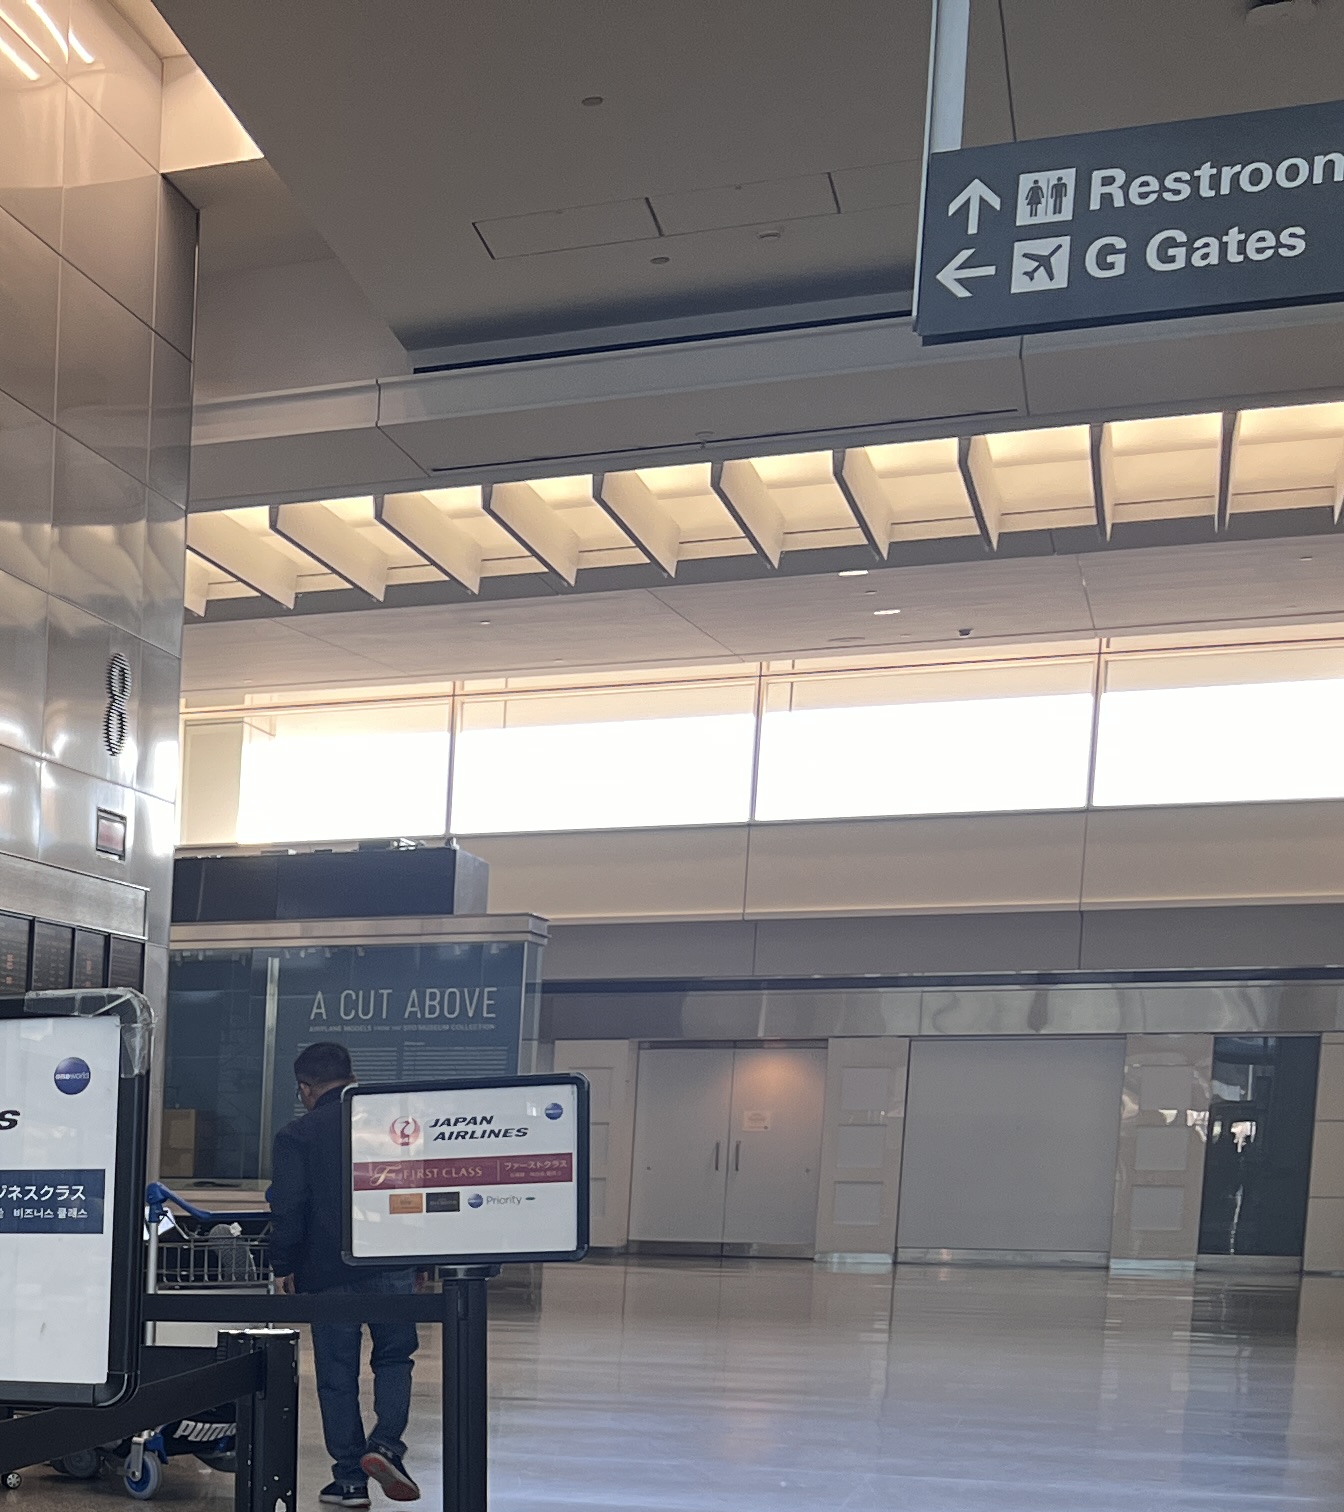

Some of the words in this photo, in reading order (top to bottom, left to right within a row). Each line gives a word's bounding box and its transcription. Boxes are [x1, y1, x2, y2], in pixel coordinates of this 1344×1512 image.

[1084, 235, 1128, 279] G
[1146, 226, 1306, 272] Gates
[310, 990, 327, 1020] A
[340, 989, 393, 1020] CUT
[404, 987, 498, 1019] ABOVE
[429, 1115, 494, 1128] JAPAN
[433, 1127, 529, 1141] AIRLINES
[403, 1169, 438, 1180] FIRST
[442, 1166, 483, 1178] CLASS
[486, 1195, 522, 1207] Priority
